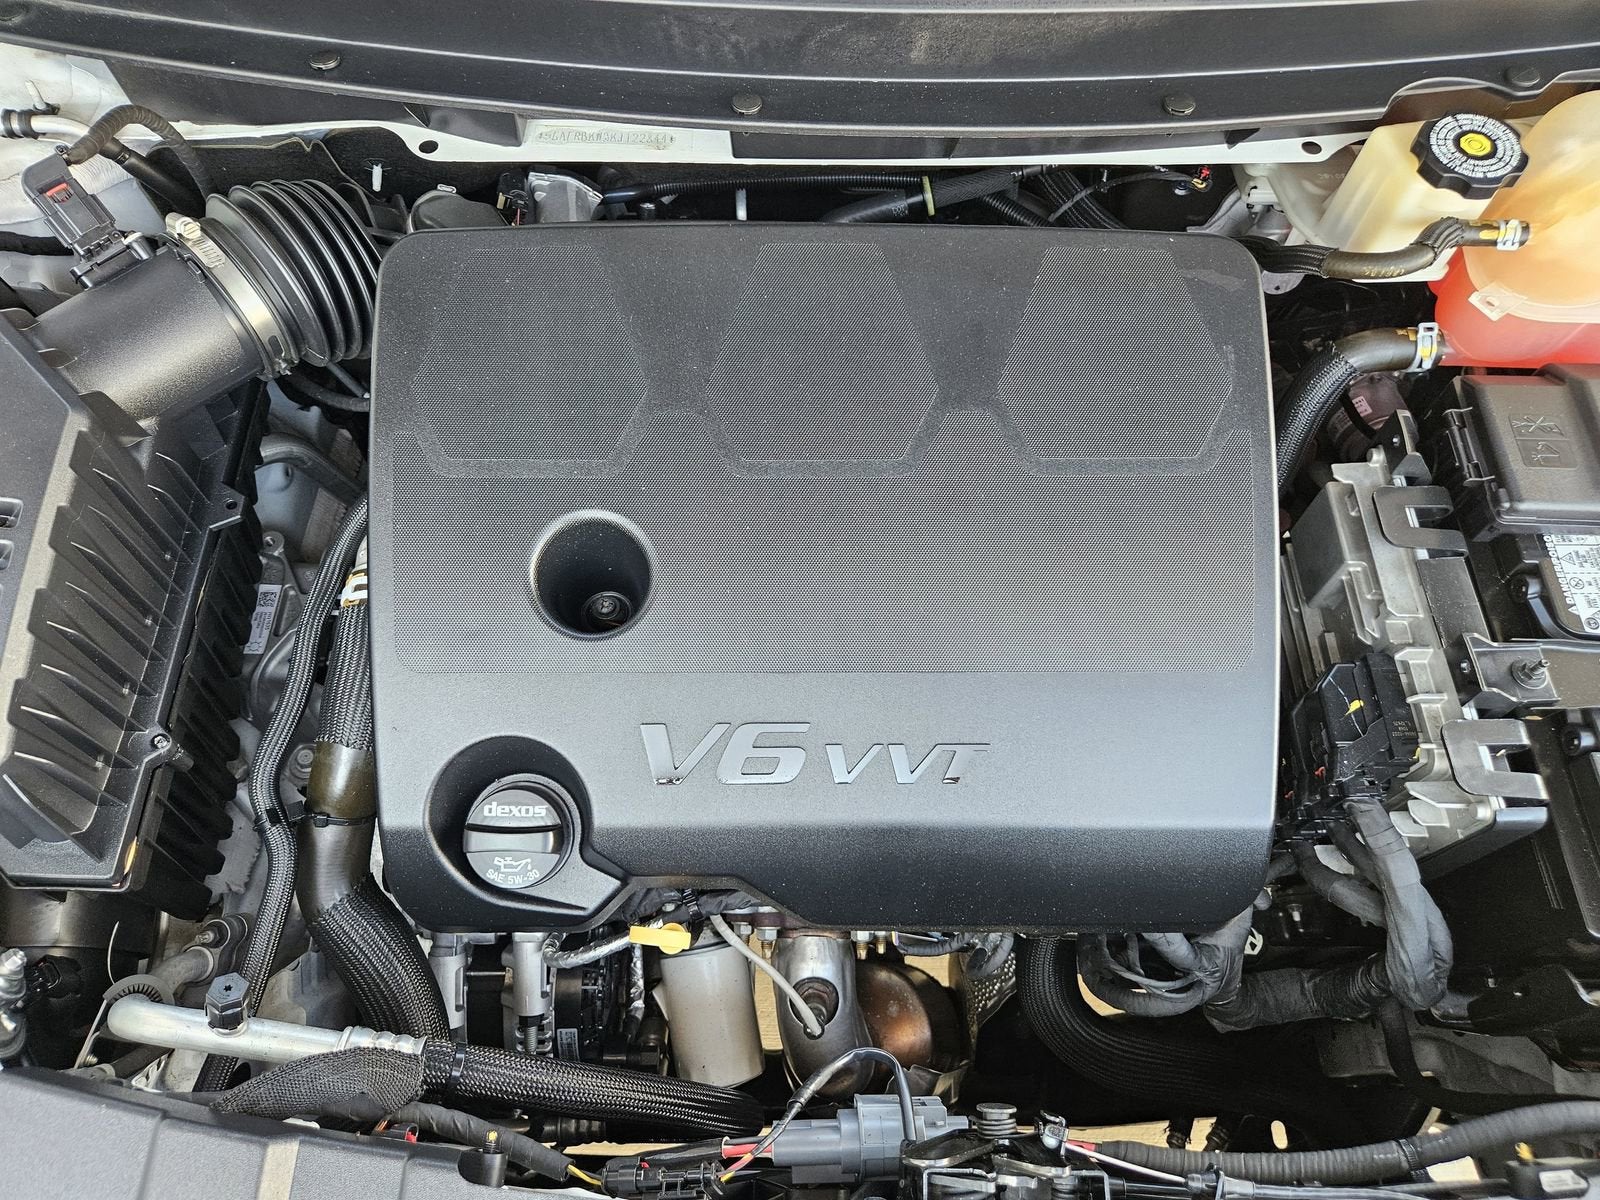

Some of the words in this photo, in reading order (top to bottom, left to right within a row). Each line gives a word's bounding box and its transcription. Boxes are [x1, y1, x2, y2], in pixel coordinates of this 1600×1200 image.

[1543, 534, 1577, 605] DANGER/POISO
[640, 722, 811, 785] V6
[825, 743, 991, 784] VVT
[483, 801, 548, 817] dexos
[486, 868, 506, 883] SAE
[507, 869, 540, 885] 5W-30
